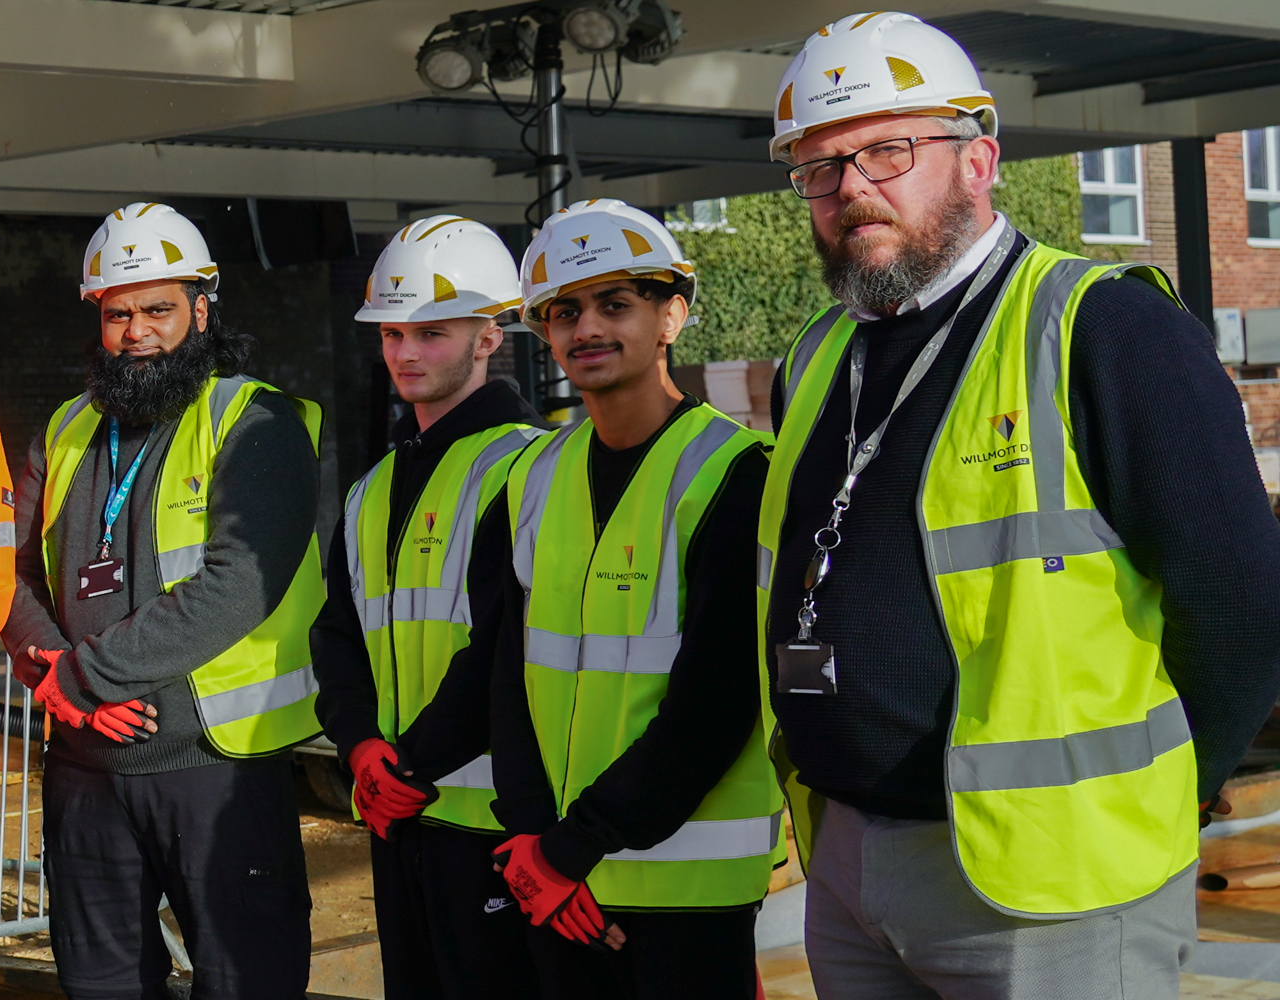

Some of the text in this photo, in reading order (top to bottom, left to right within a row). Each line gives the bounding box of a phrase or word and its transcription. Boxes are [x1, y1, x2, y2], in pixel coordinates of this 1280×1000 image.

[960, 444, 1017, 465] WILLMOTT
[995, 461, 1013, 471] SINCE
[167, 496, 204, 510] WILLMOTT
[488, 898, 506, 907] NIKE
